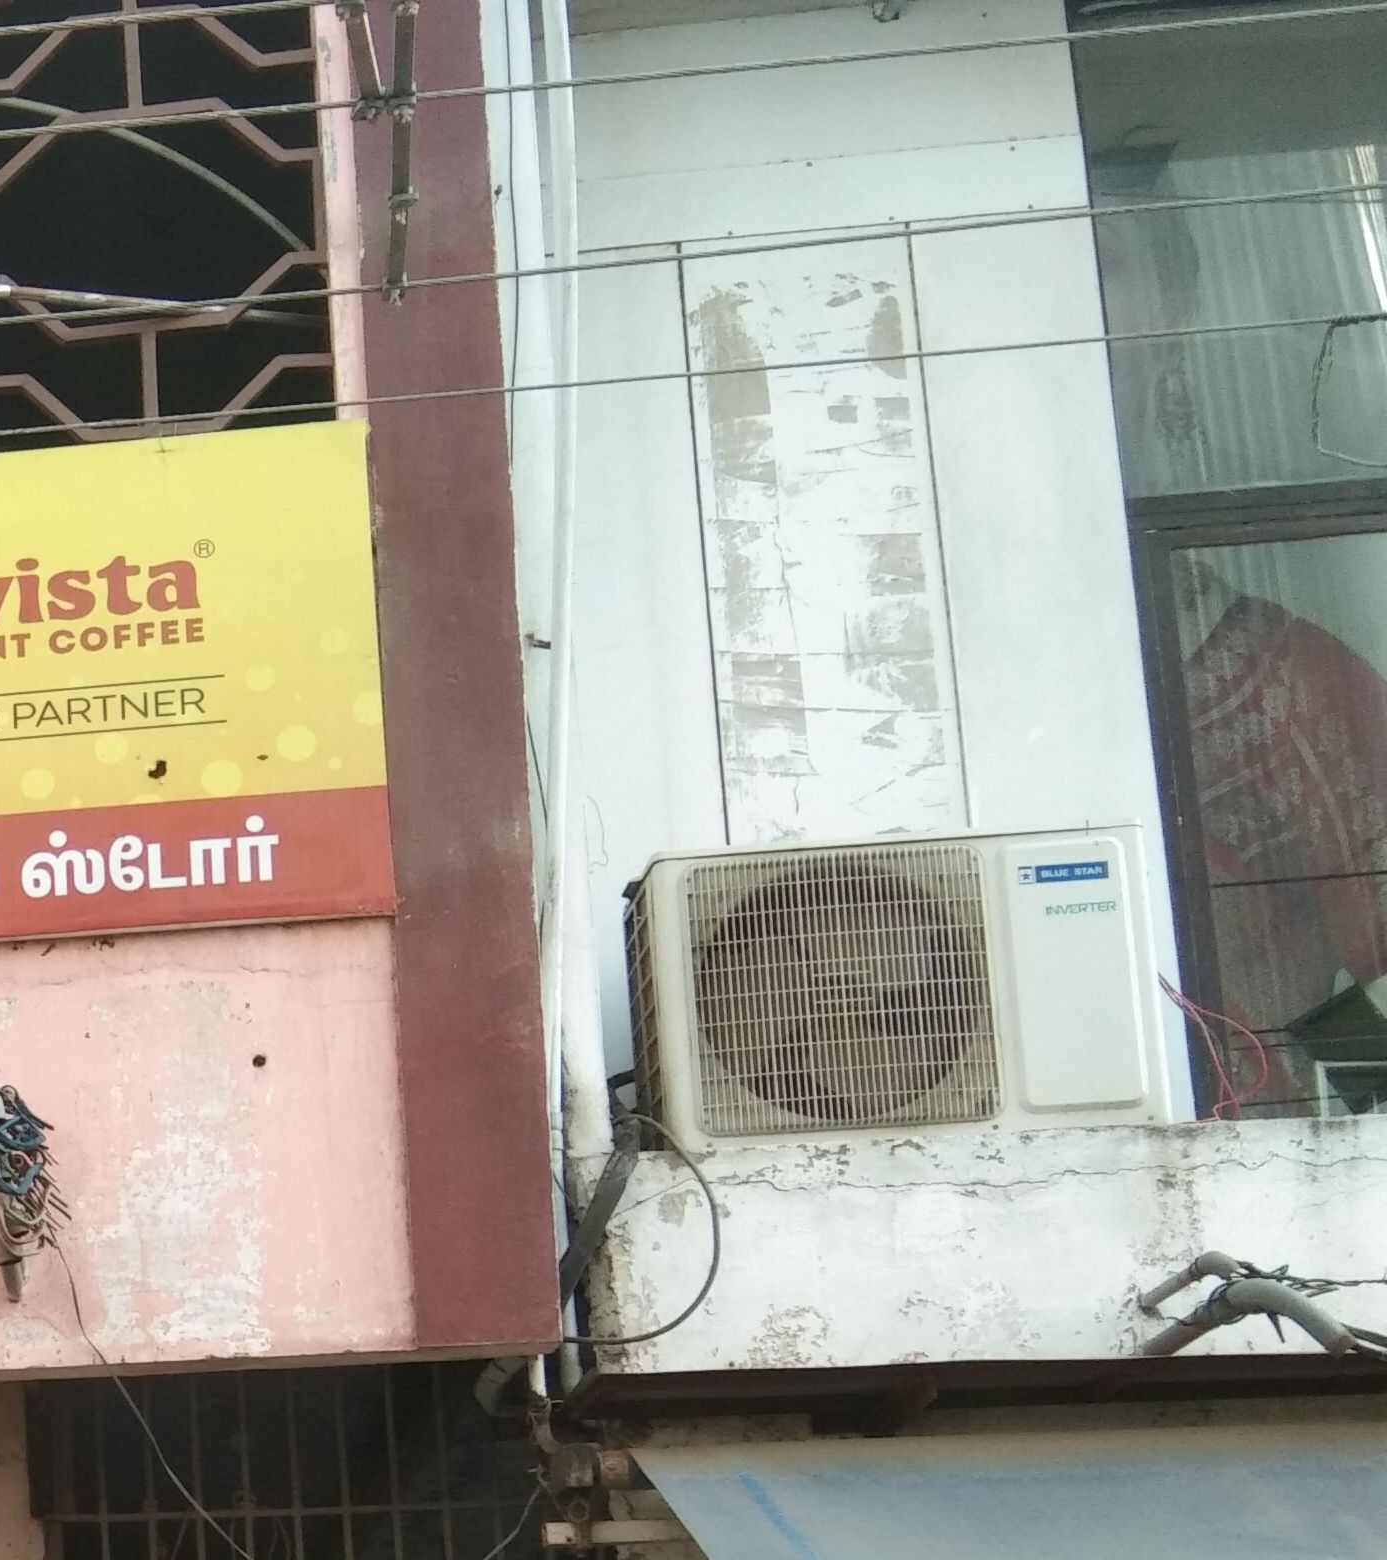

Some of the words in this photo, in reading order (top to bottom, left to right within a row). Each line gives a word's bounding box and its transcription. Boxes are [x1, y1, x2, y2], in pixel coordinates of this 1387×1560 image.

[48, 618, 204, 655] COFFEE
[12, 687, 206, 729] PARTNER
[21, 817, 279, 899] ஸ்டோர்
[1046, 900, 1117, 915] INVERTER
